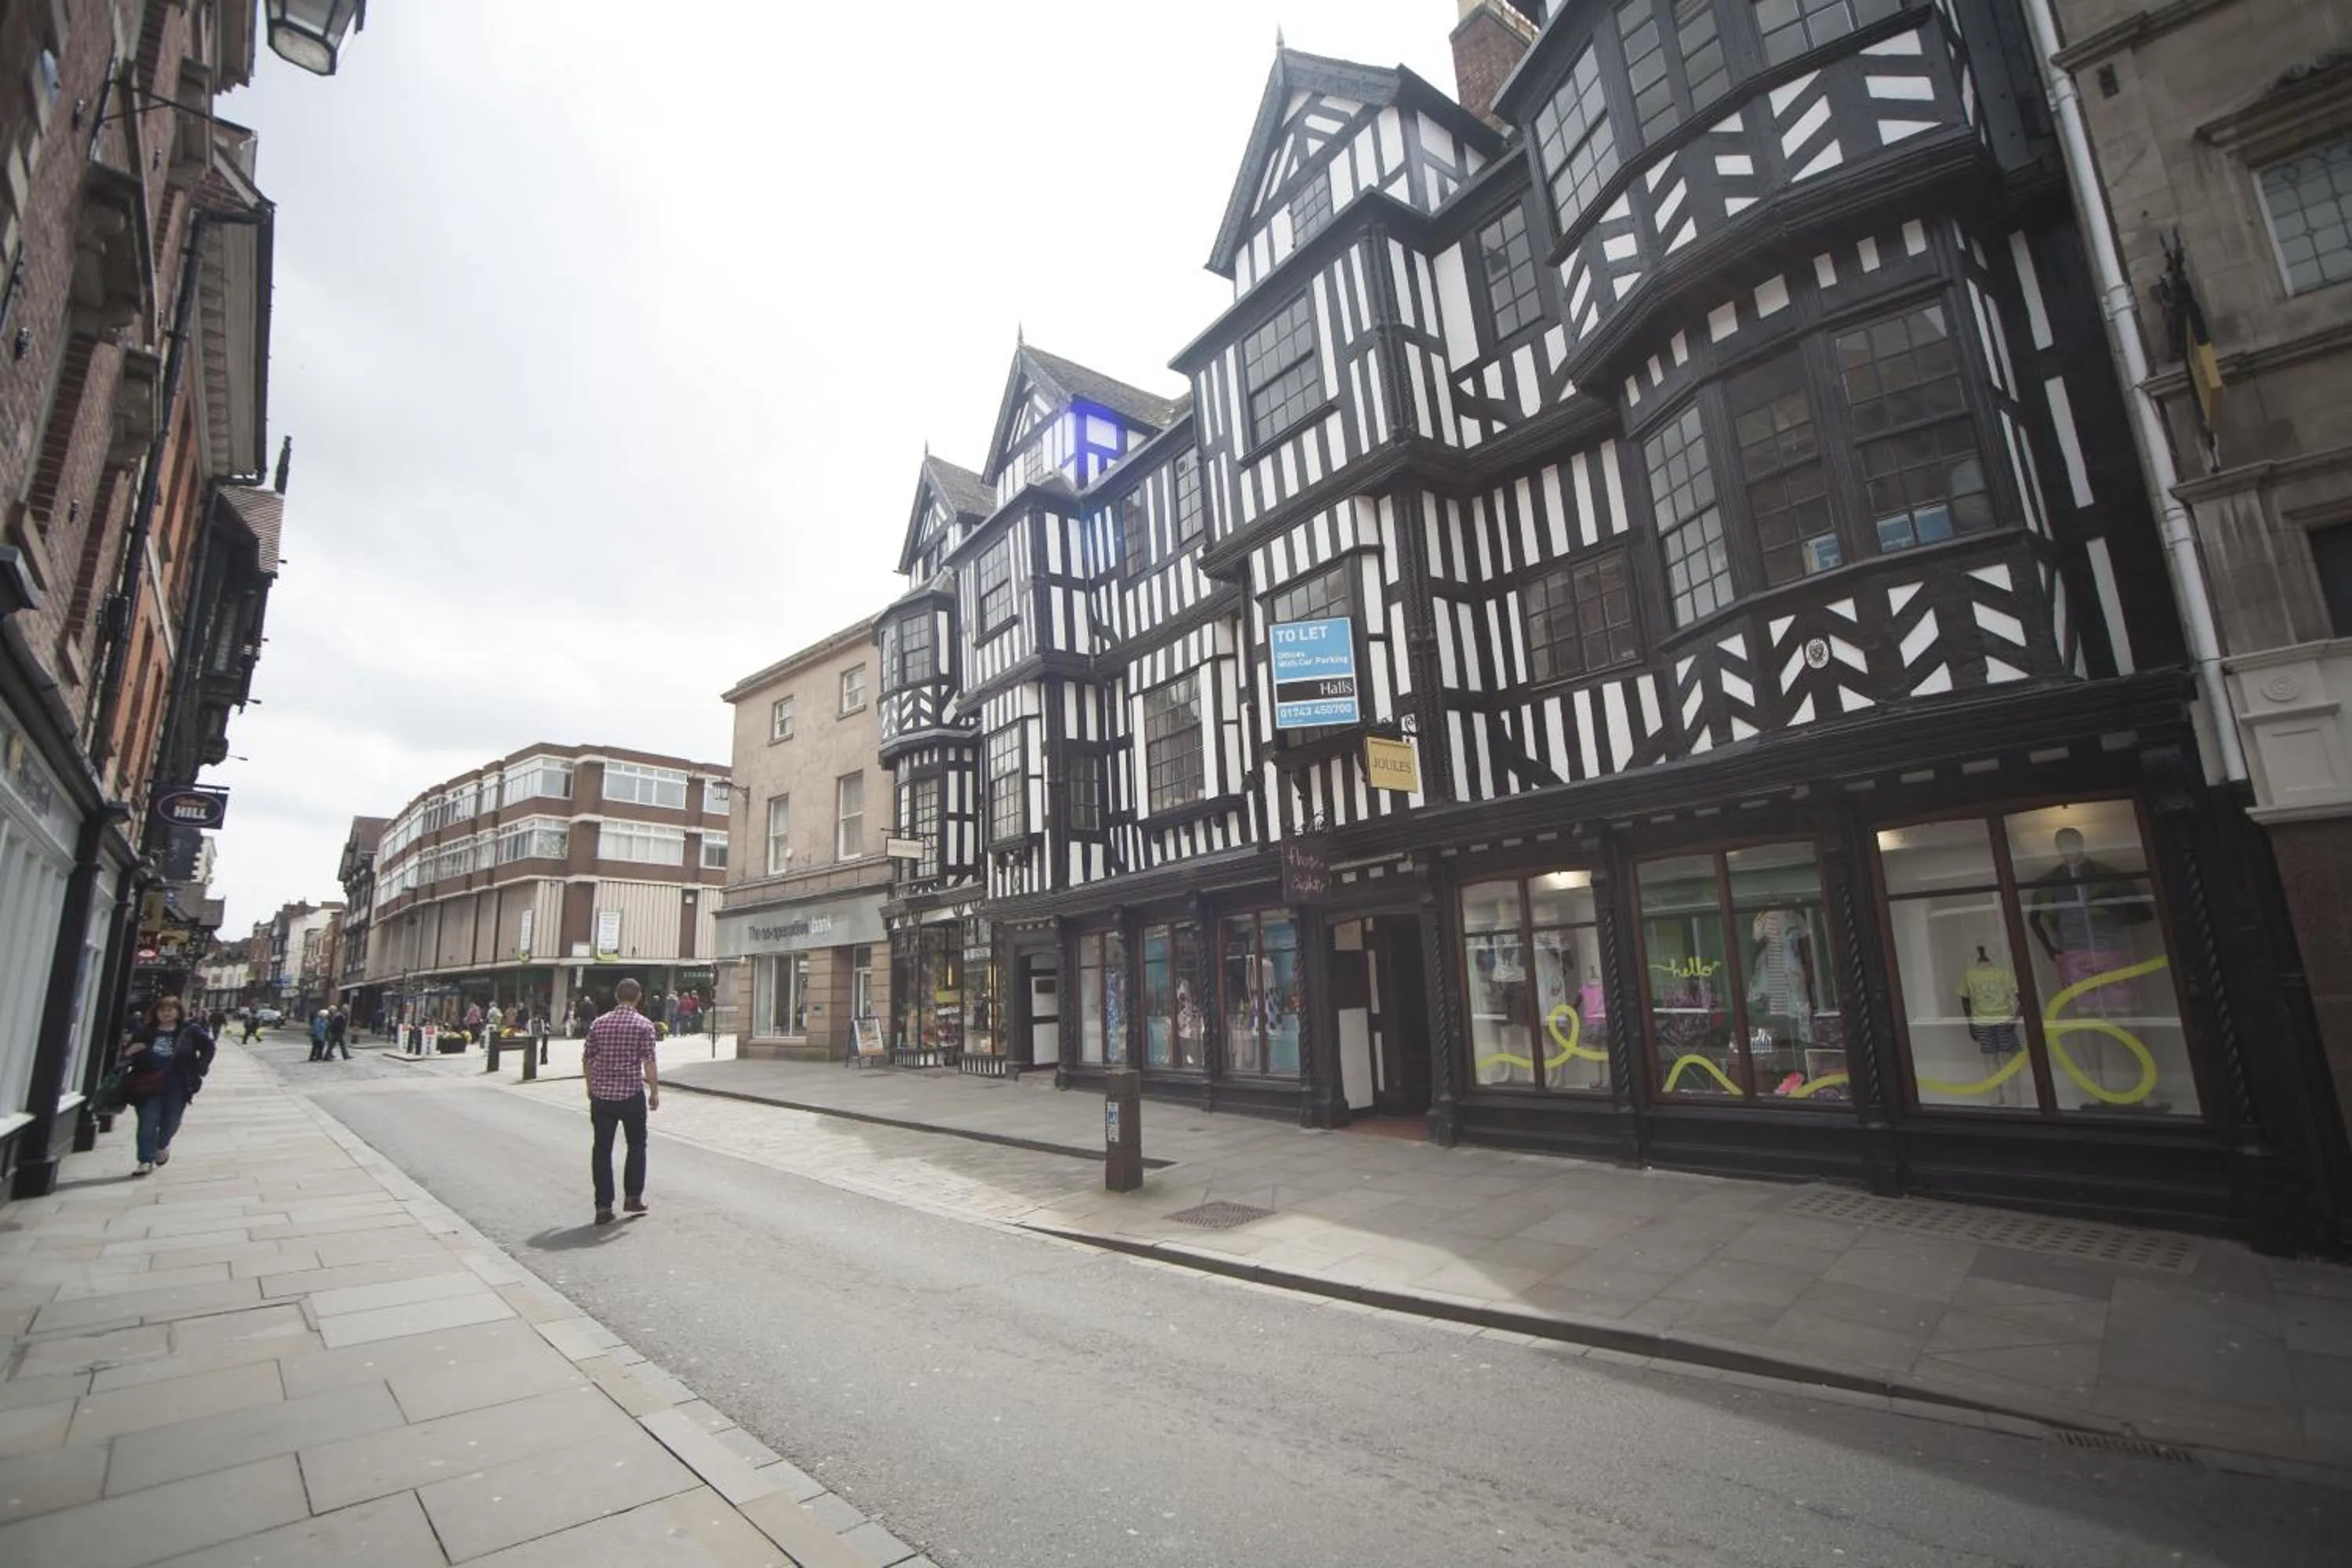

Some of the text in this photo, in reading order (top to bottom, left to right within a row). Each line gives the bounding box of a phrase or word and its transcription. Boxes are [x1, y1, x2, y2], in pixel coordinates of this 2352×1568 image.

[1276, 626, 1329, 643] TO LET
[1314, 655, 1348, 666] Parking
[1319, 680, 1353, 695] Halls
[1373, 758, 1412, 774] JOULES
[173, 805, 207, 819] HILL
[748, 926, 760, 942] The
[811, 915, 832, 935] bank
[1654, 956, 1721, 978] hello
